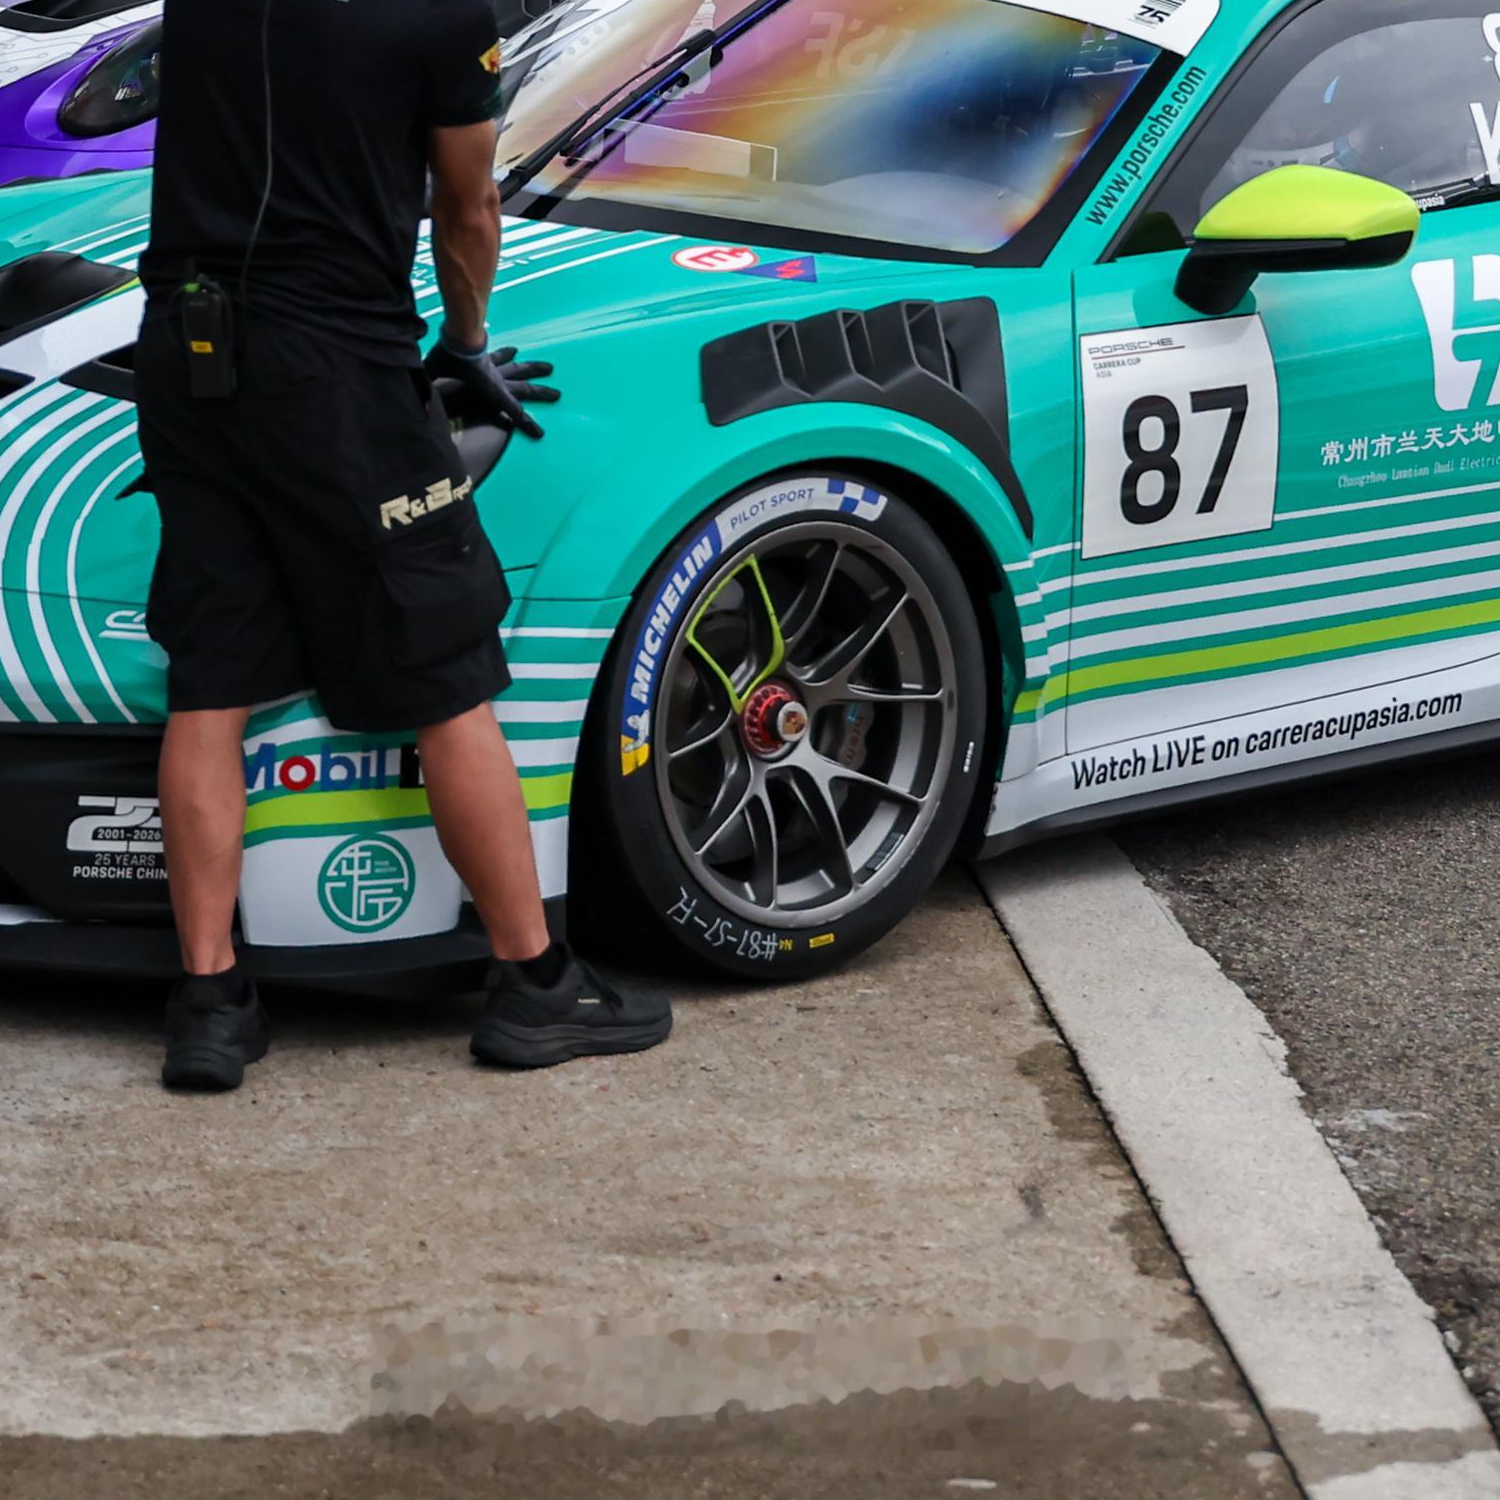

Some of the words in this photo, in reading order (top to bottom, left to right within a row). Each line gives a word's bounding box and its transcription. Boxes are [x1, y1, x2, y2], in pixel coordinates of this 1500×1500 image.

[1138, 4, 1171, 24] 75
[1085, 63, 1208, 227] www.porsche.com
[1088, 337, 1174, 355] PORSCHE
[1092, 357, 1127, 371] CARRERA
[1127, 356, 1142, 367] CUP
[1120, 383, 1250, 526] 87
[1459, 454, 1500, 471] Electric
[379, 477, 455, 530] R&B
[729, 501, 769, 531] PILOT
[770, 487, 816, 513] SPORT
[630, 534, 715, 706] MICHELIN
[1071, 747, 1147, 790] Watch
[1151, 734, 1206, 773] LIVE
[1211, 737, 1240, 761] on
[1244, 691, 1463, 756] carreracupasia.com
[242, 742, 388, 791] Mobil
[97, 829, 162, 842] 2001-2026
[73, 866, 134, 879] PORSCHE
[135, 867, 169, 880] CHIN
[94, 853, 112, 866] 25
[114, 853, 156, 867] YEARS
